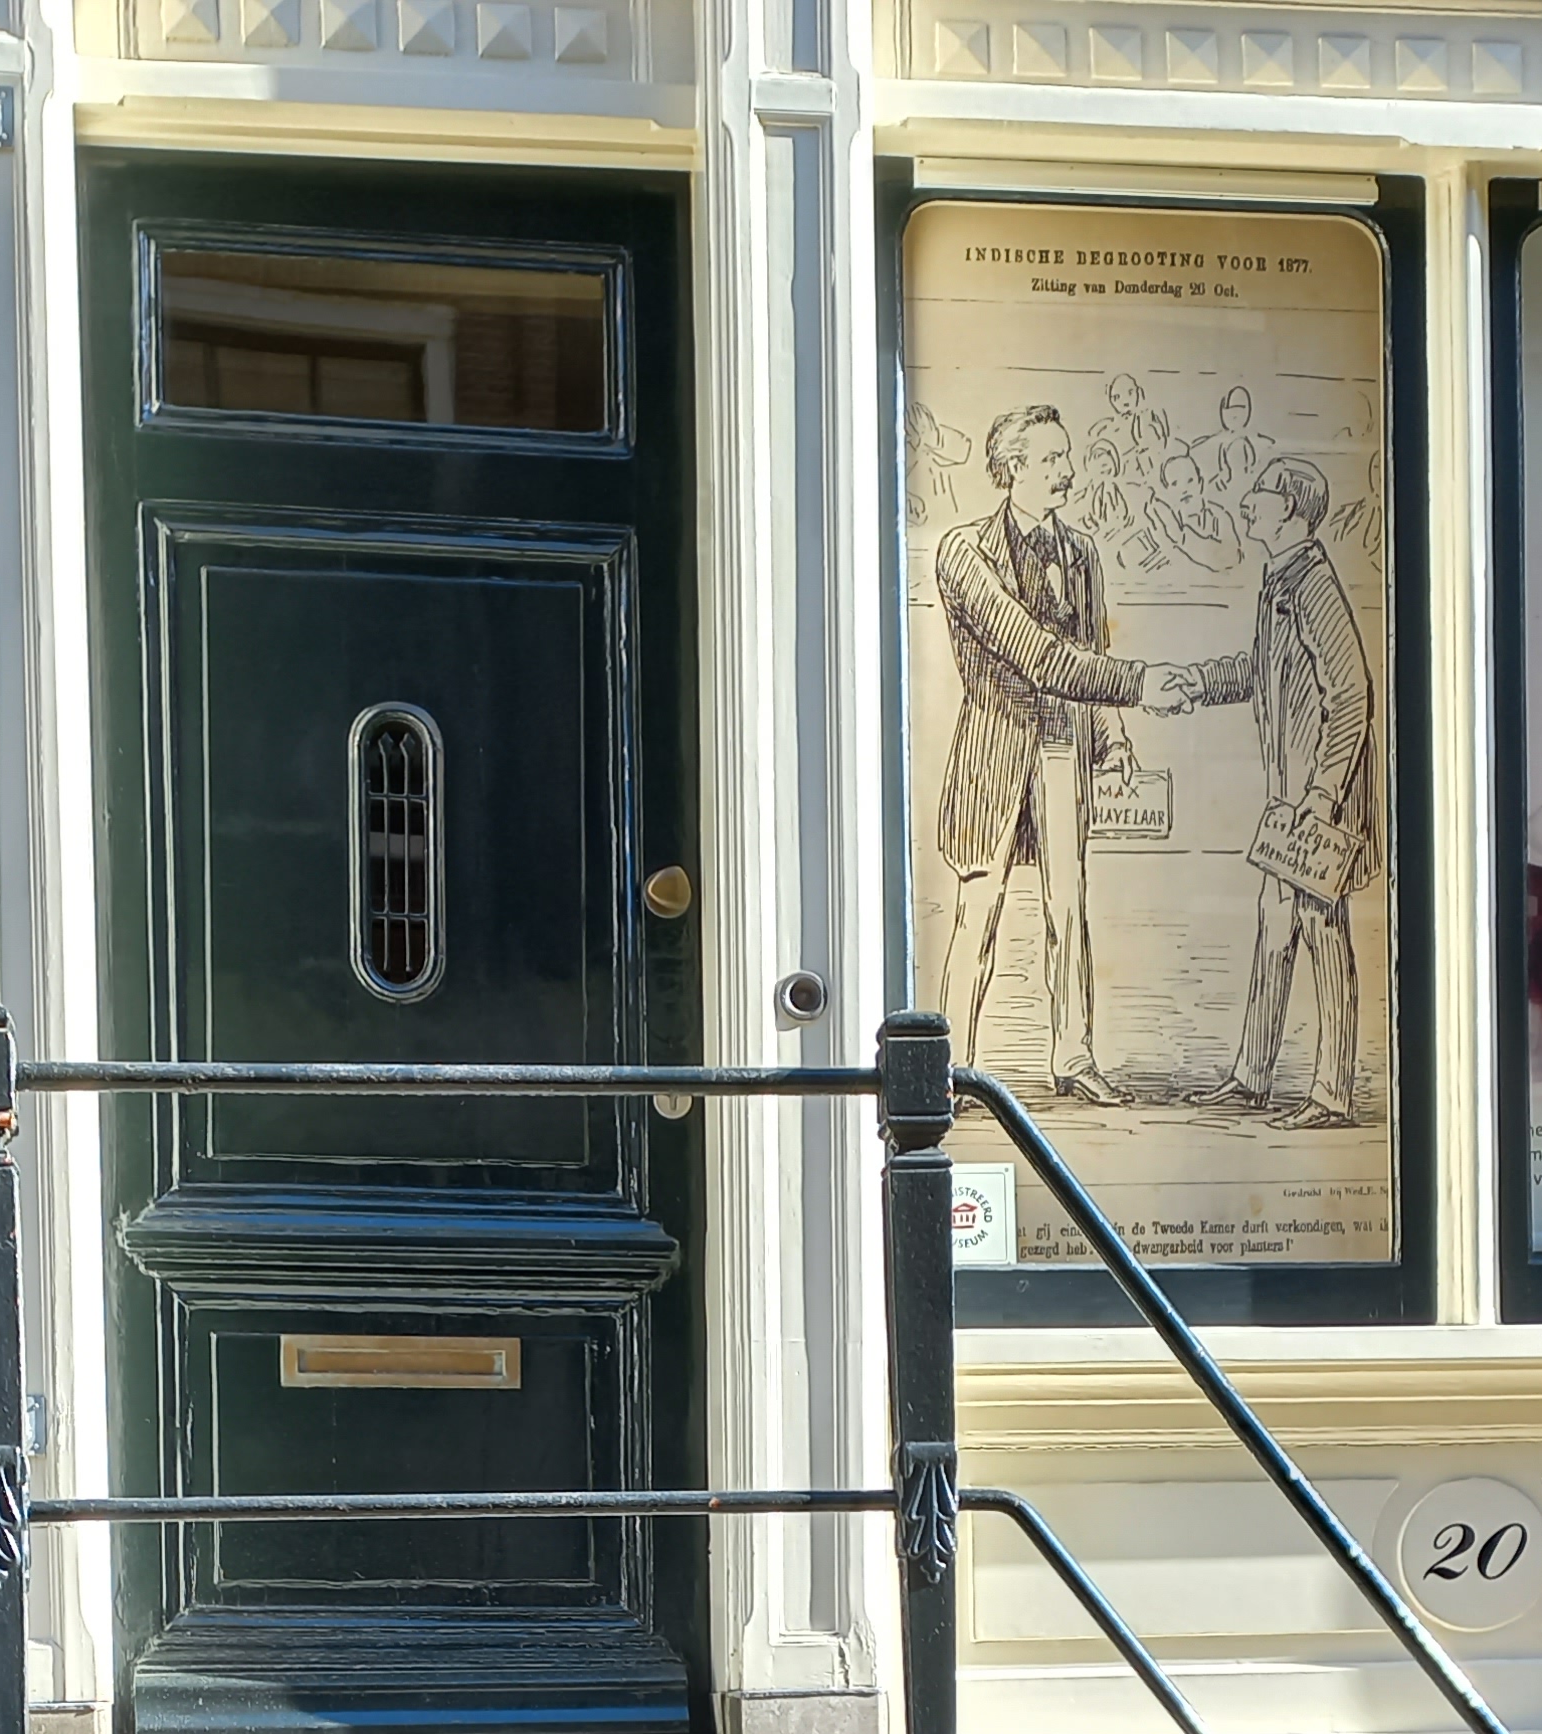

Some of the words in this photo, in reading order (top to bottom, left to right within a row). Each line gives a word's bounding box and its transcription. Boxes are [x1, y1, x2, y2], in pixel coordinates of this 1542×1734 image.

[965, 247, 1064, 264] INDISCHE
[1217, 254, 1267, 272] VOOR
[1278, 258, 1313, 273] 1877.
[1031, 278, 1076, 296] Zitting
[1083, 283, 1106, 293] van
[1114, 279, 1182, 297] Donderdag
[1214, 283, 1239, 298] Oct.
[1098, 785, 1139, 799] MAX
[1093, 806, 1165, 826] HAVELAAR
[952, 1187, 992, 1223] ISTREERD
[1036, 1223, 1051, 1241] gij
[1131, 1222, 1146, 1235] de
[1152, 1220, 1194, 1235] Tweede
[1200, 1220, 1235, 1234] Kamer
[1242, 1219, 1268, 1234] durft
[1275, 1219, 1346, 1235] verkondigen,
[1353, 1220, 1373, 1232] wat
[1020, 1242, 1060, 1259] gezegd
[1066, 1241, 1094, 1256] heb.
[1133, 1240, 1203, 1256] dwangarbeid
[1209, 1242, 1233, 1253] voor
[1423, 1523, 1527, 1581] 20
